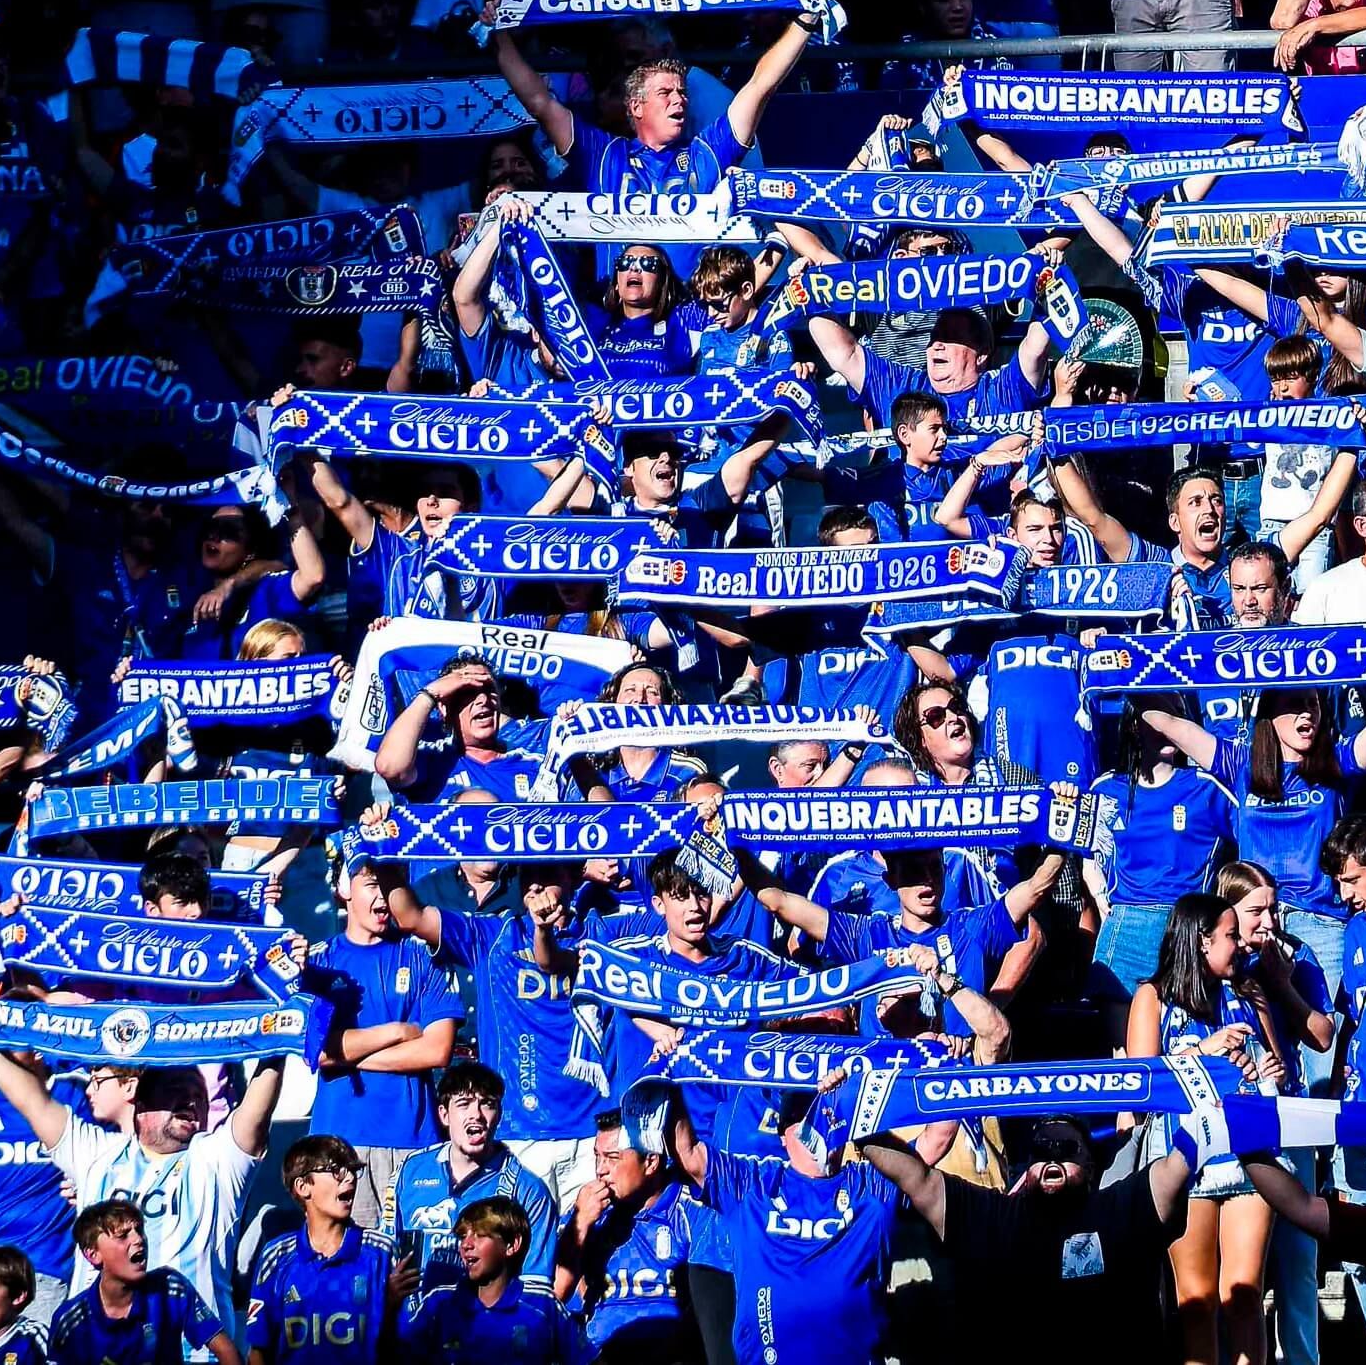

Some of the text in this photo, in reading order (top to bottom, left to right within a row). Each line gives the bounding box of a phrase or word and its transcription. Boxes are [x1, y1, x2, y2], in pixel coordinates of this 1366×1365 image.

[975, 86, 1282, 114] INQUEBRANTABLES
[871, 192, 986, 220] CICLO
[811, 256, 1033, 304] Real OVIEDO
[389, 422, 509, 452] CICLO
[1045, 399, 1357, 444] DESDE1926REALOVIEDO
[503, 542, 620, 571] CICLO
[698, 556, 936, 597] Real OVIEDO 1926
[1047, 566, 1119, 604] 1926
[481, 627, 547, 649] Real
[1215, 648, 1337, 679] CICLO
[726, 793, 1040, 831] INQUEBRANTABLES
[97, 939, 209, 976] CICLO
[31, 1014, 97, 1037] AZUL
[154, 1018, 259, 1042] SOMIEDO
[743, 1049, 874, 1080] CICLO
[924, 1075, 1143, 1101] CARBAYONES
